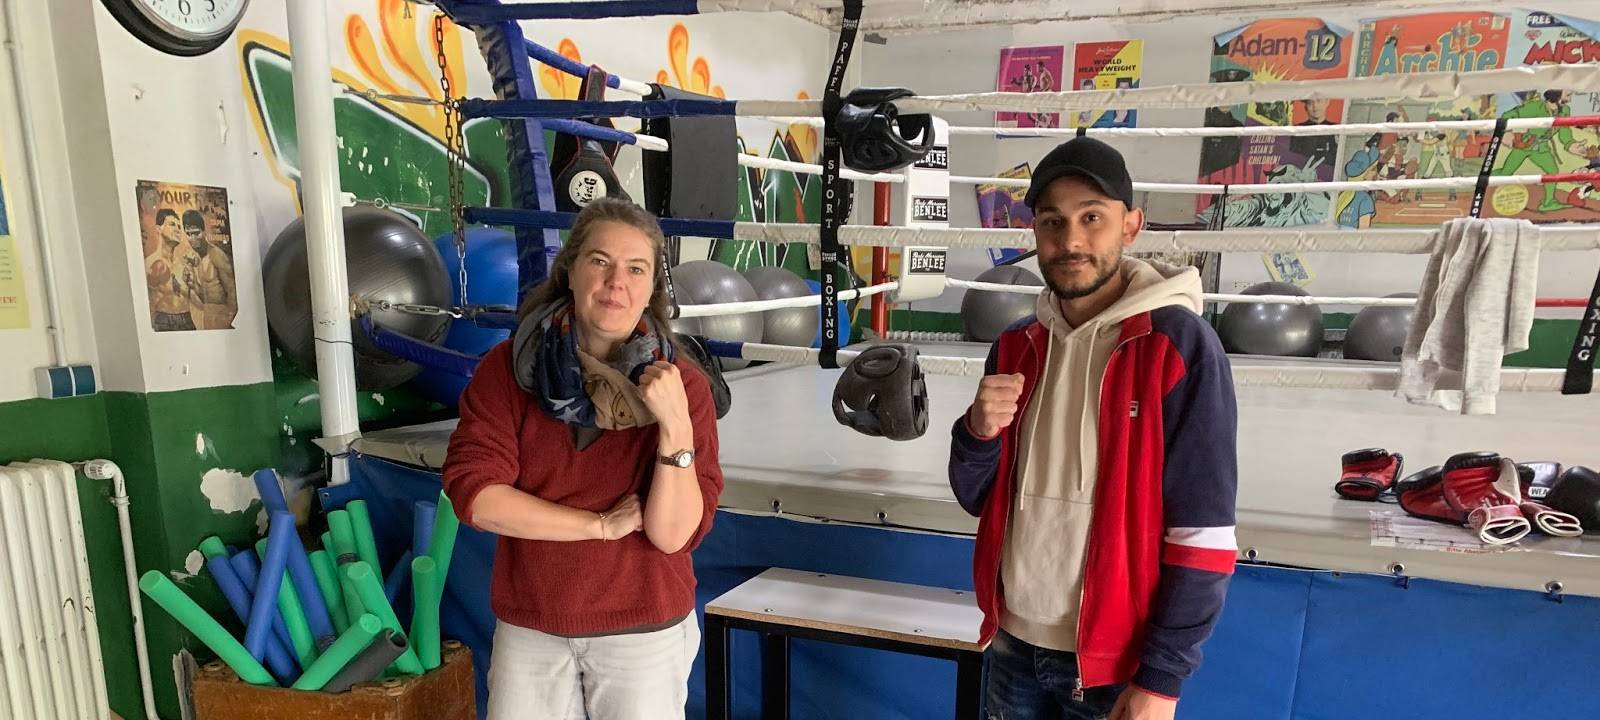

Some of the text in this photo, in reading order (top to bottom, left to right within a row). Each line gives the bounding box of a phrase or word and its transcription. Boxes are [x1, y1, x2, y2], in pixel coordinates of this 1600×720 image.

[829, 42, 848, 92] PAFF
[1360, 31, 1371, 77] ARCHI
[1373, 32, 1499, 77] Archie
[156, 190, 192, 207] YOUR
[826, 160, 834, 228] SPORT
[914, 205, 946, 218] BENLEE
[912, 258, 944, 270] BENLEE
[826, 274, 834, 339] BOXING
